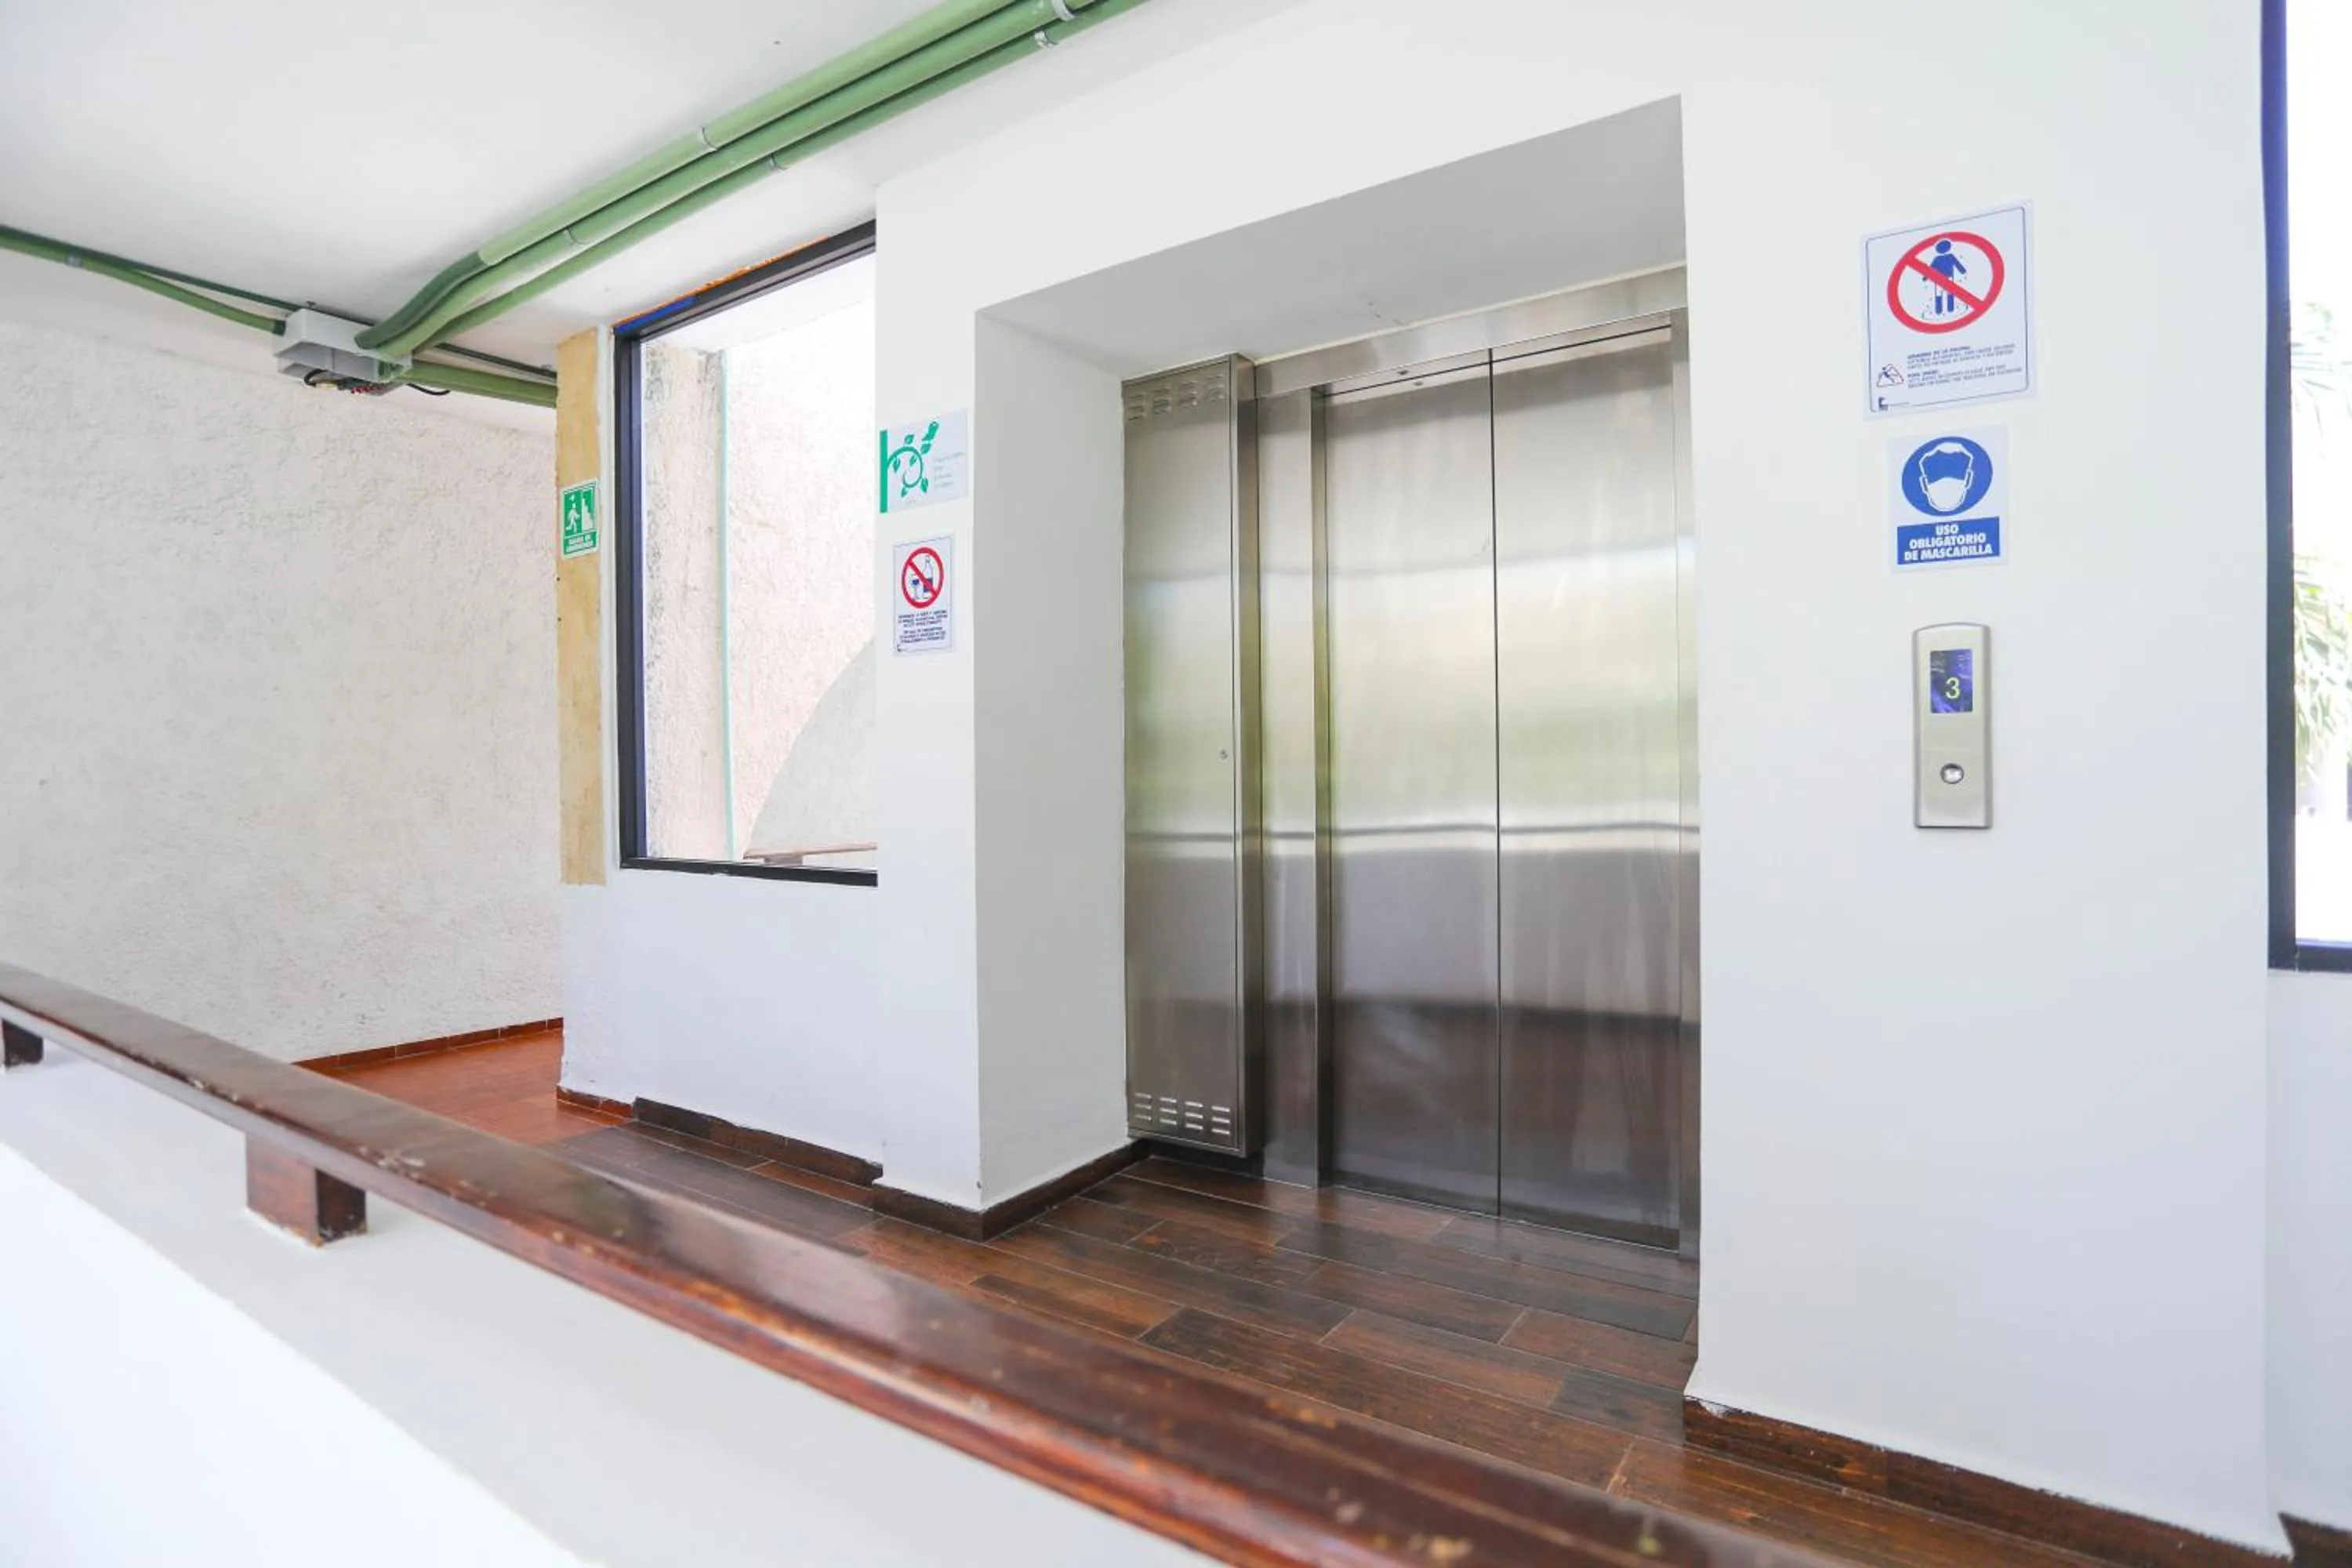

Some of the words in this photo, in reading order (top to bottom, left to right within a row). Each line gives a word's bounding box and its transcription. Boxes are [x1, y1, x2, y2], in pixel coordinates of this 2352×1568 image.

[1936, 524, 1959, 535] USO
[1910, 533, 1986, 549] OBLIGATORIO
[1904, 550, 1918, 561] DE
[1922, 544, 1992, 559] MASCARILLA
[1945, 677, 1961, 699] 3
